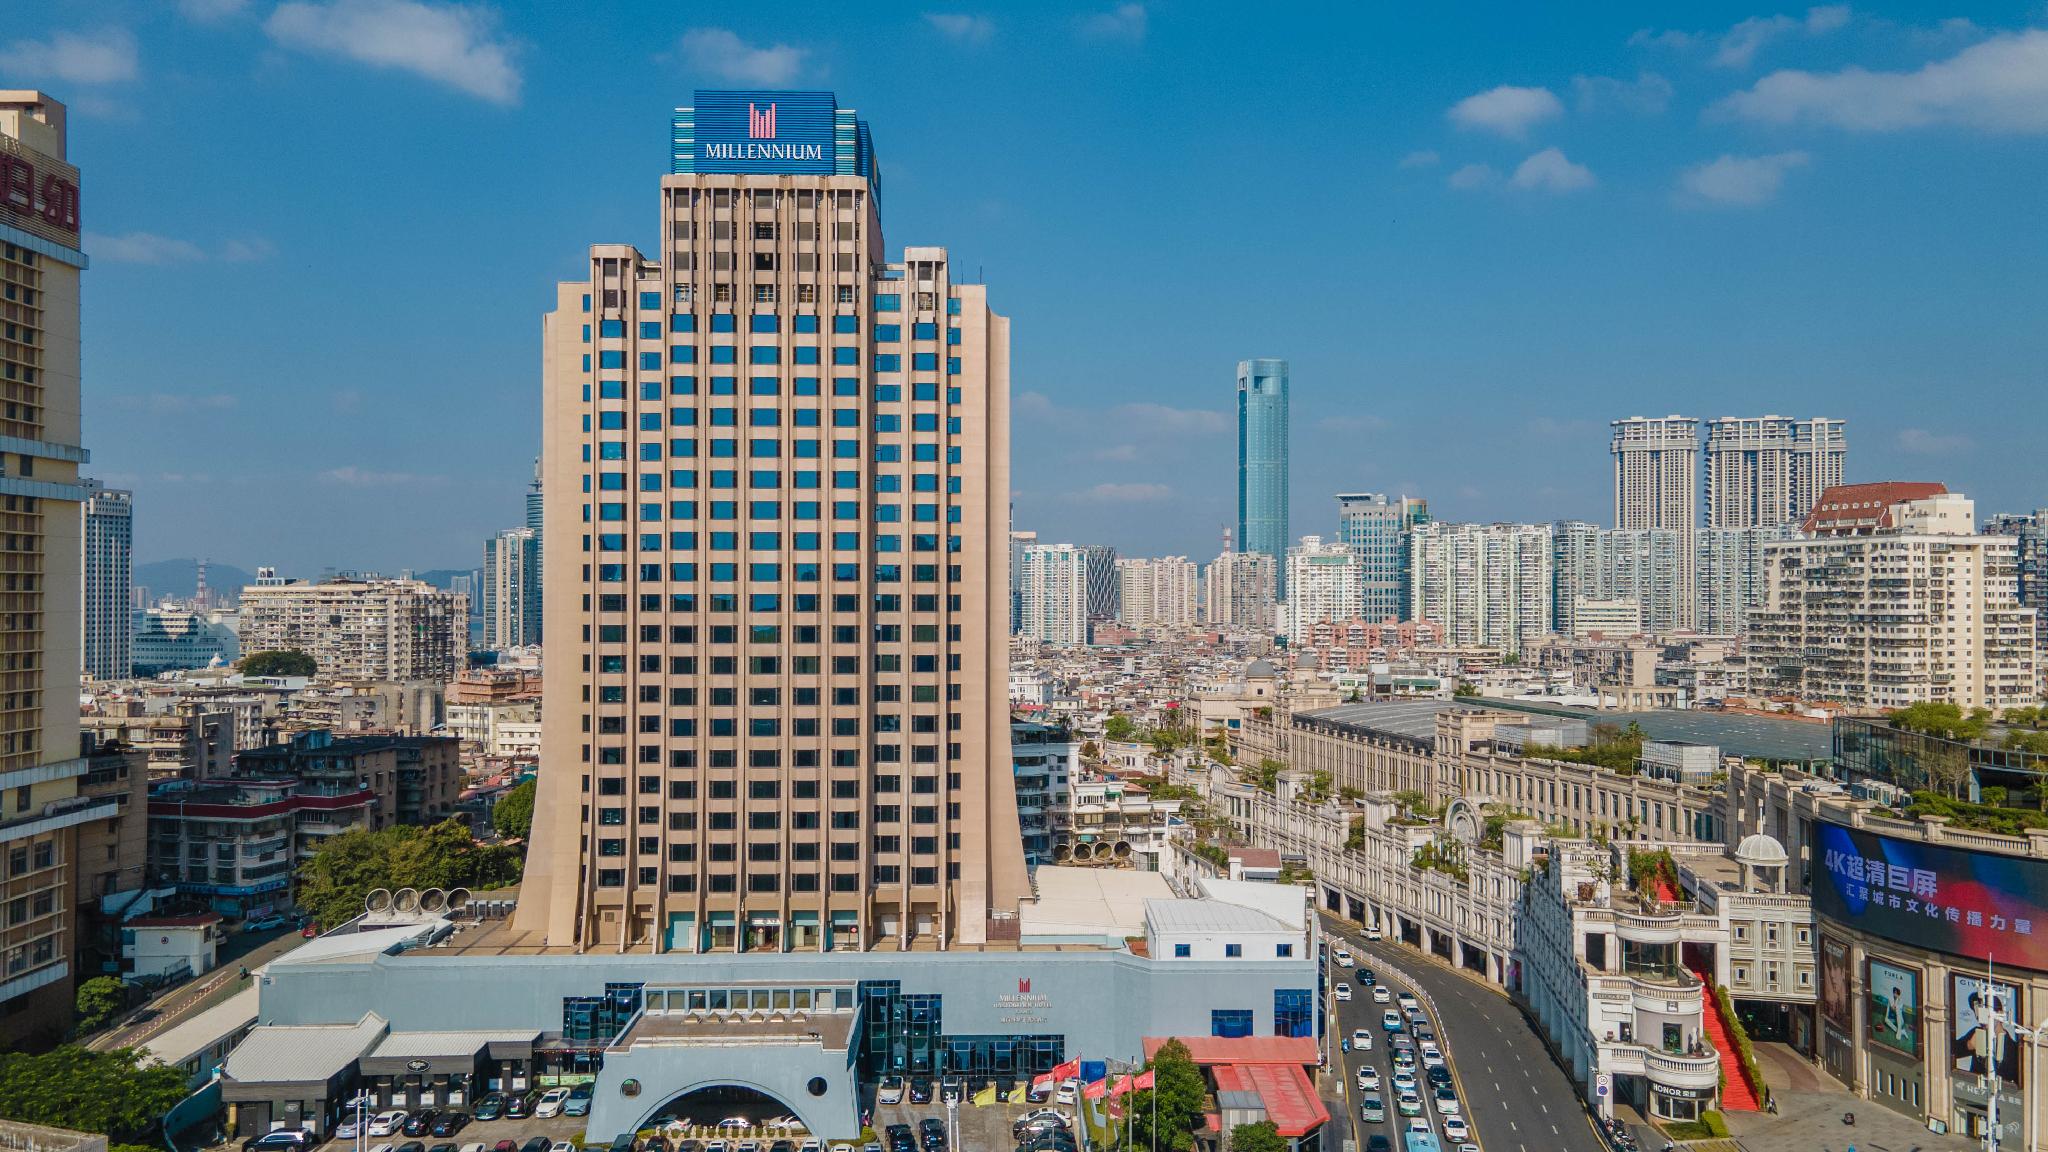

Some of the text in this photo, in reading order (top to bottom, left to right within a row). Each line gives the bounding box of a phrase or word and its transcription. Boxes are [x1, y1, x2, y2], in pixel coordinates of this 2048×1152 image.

[705, 143, 822, 160] MILLENNIUM
[1824, 848, 1938, 898] 4K超清巨屏
[1845, 882, 2032, 935] 汇聚城市文化传播力量
[1884, 970, 1904, 980] FURLA
[1653, 1083, 1682, 1097] HONOR
